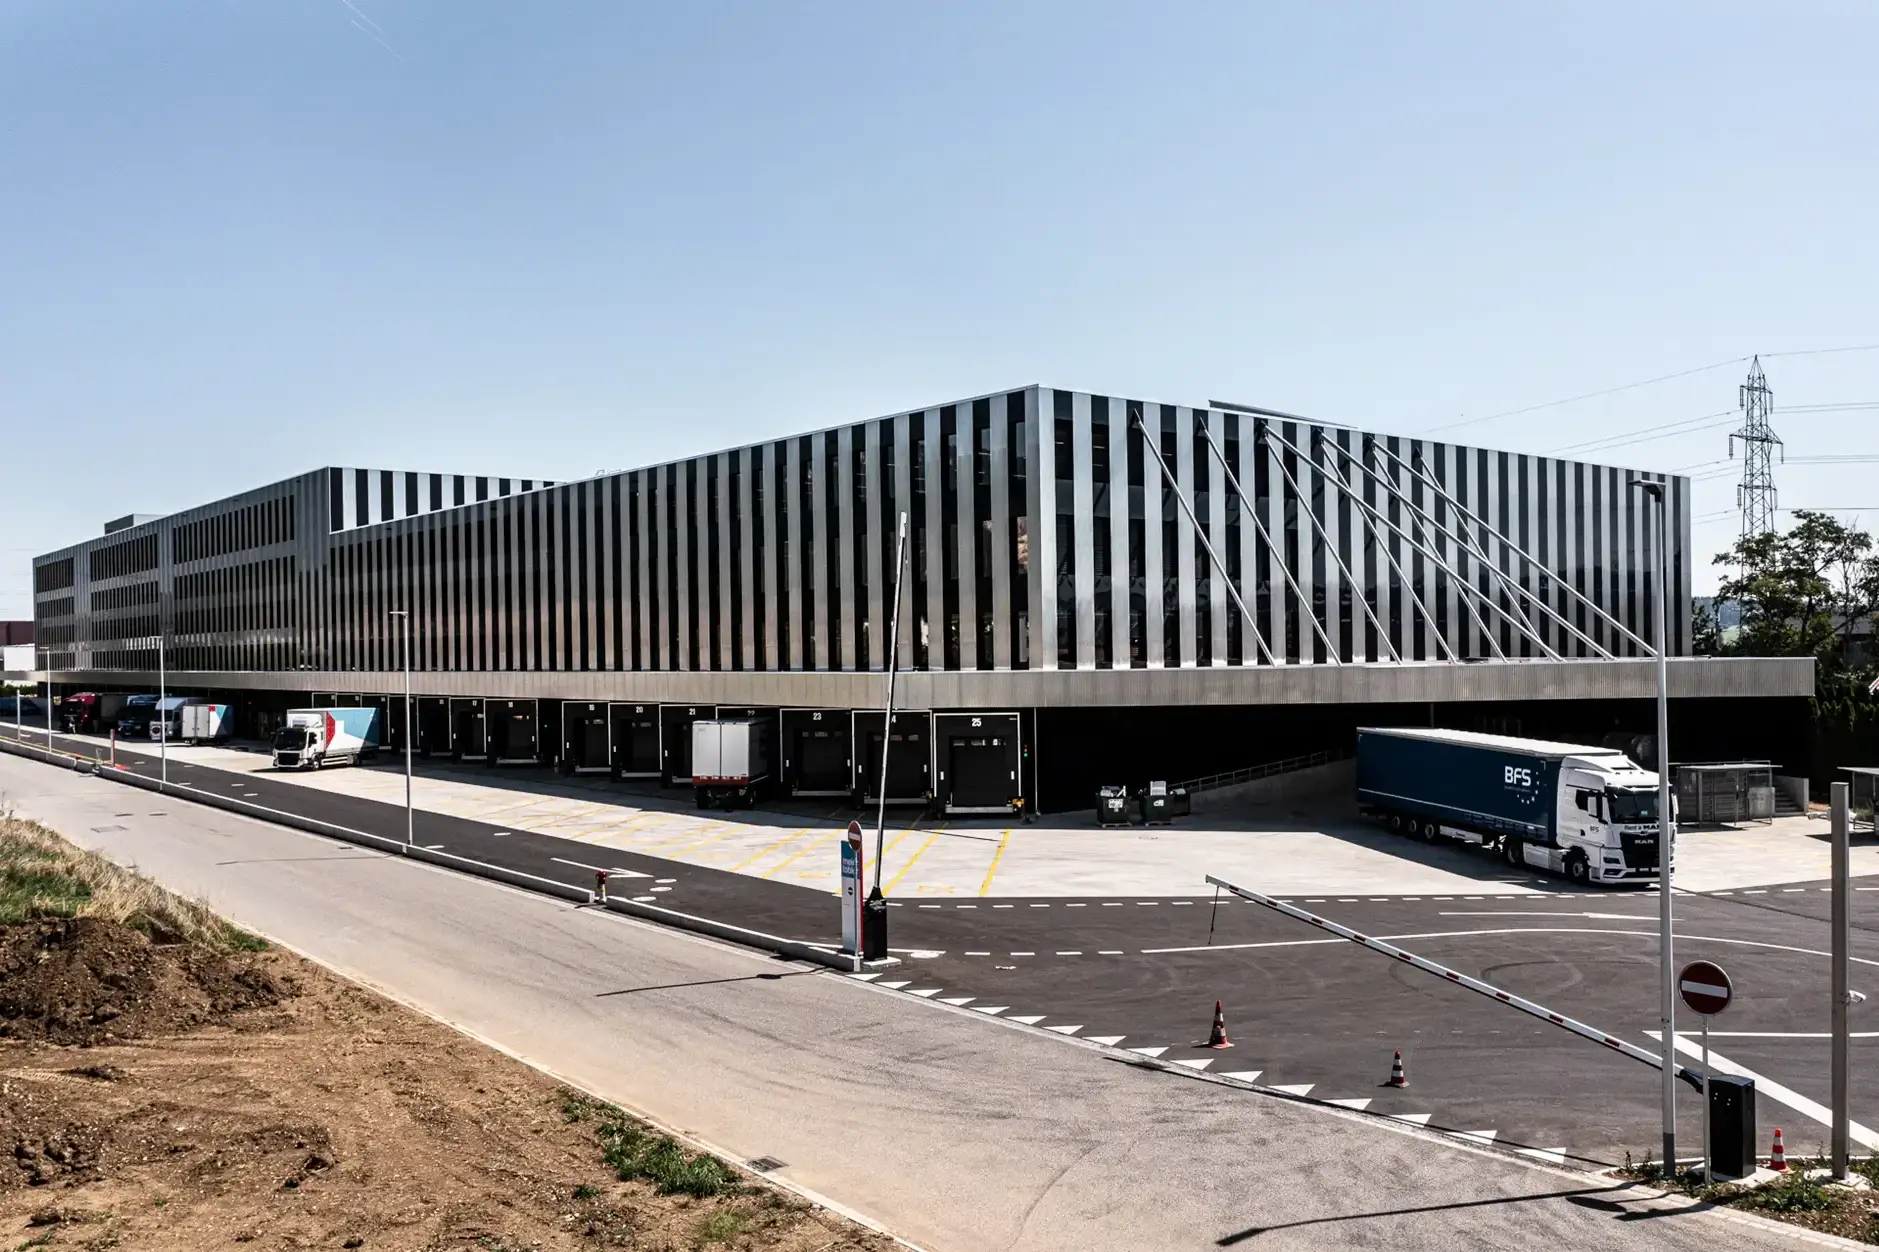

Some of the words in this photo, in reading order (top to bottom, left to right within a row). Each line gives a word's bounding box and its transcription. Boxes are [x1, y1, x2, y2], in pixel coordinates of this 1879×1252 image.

[635, 705, 644, 714] 20
[688, 708, 697, 716] 21
[812, 712, 823, 721] 23
[971, 717, 982, 727] 25
[1504, 765, 1531, 787] BFS
